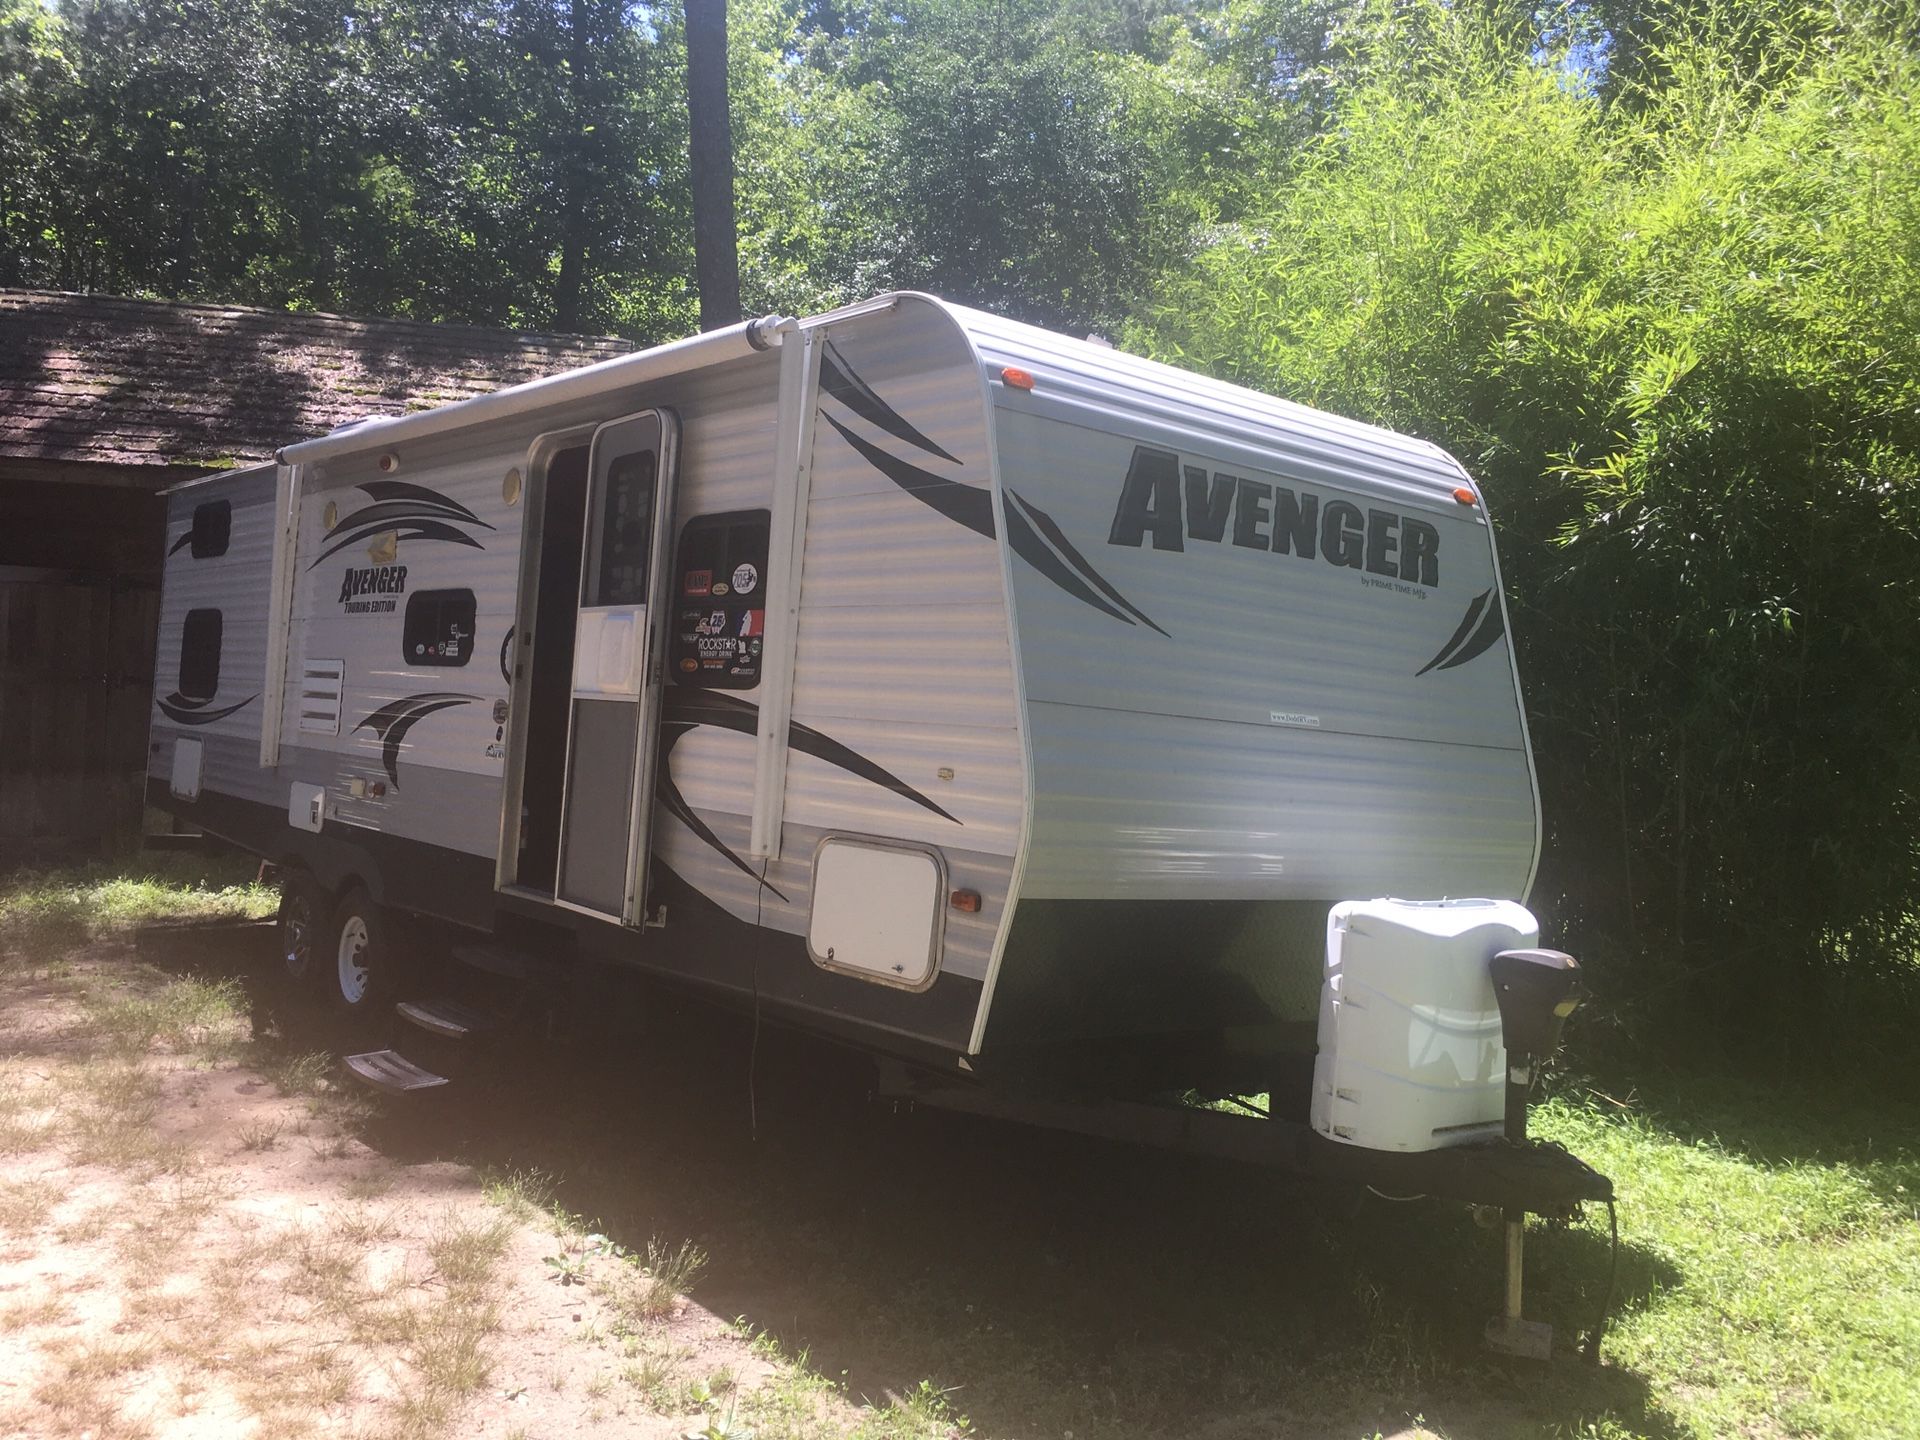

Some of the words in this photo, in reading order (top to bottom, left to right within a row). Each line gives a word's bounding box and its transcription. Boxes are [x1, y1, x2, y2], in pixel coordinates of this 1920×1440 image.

[1107, 445, 1440, 588] AVENGER
[338, 566, 407, 603] AVENGER
[1361, 576, 1370, 587] by
[1370, 579, 1393, 591] PRIME
[1394, 584, 1412, 595] TIME
[344, 601, 371, 614] TOURING
[370, 600, 397, 613] EDITION
